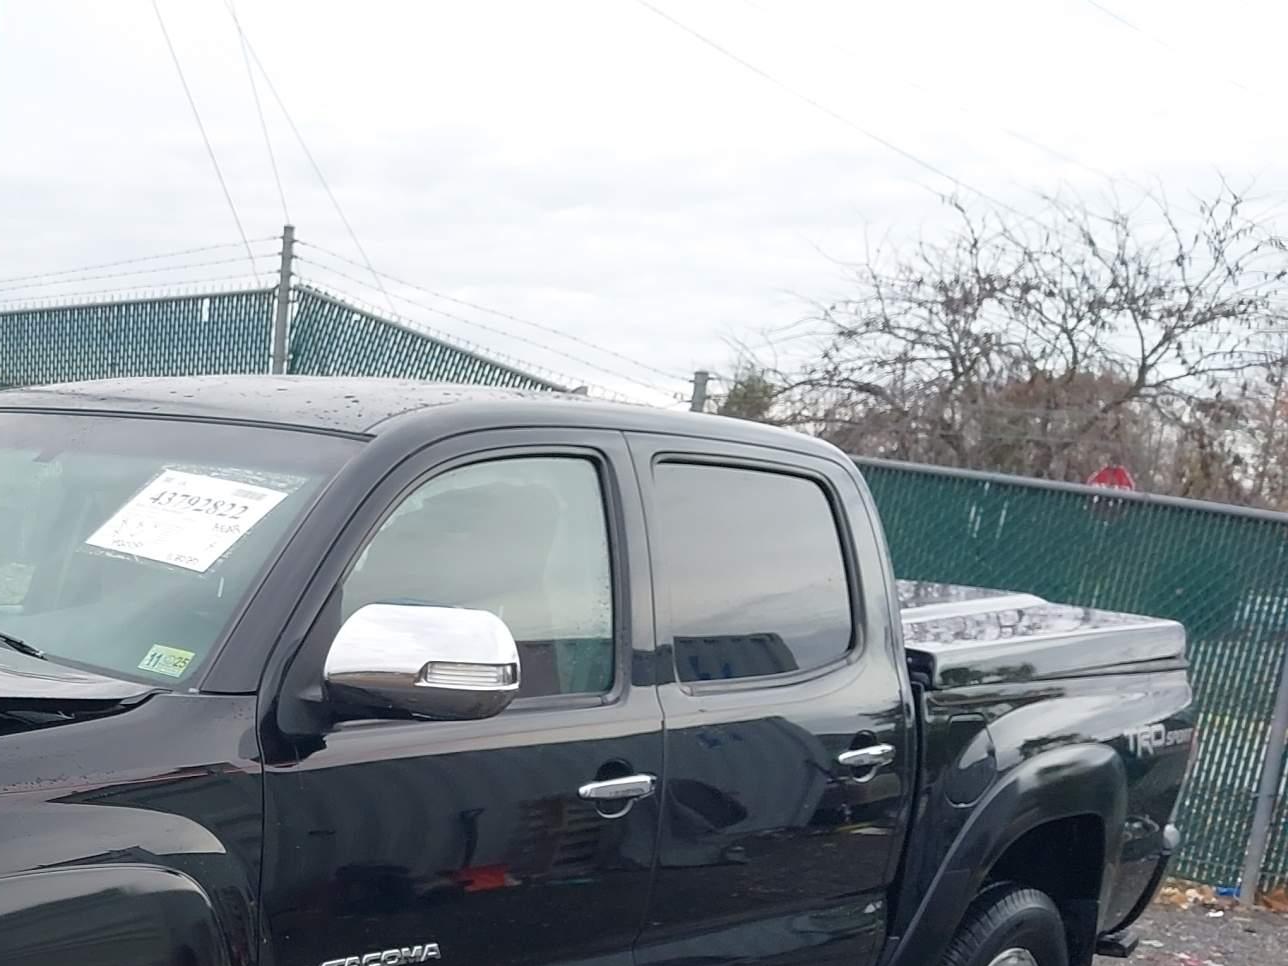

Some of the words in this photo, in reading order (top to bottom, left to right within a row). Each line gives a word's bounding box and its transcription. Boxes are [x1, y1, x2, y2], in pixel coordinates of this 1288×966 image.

[150, 490, 248, 519] 43792822
[146, 652, 162, 667] 11
[173, 656, 190, 668] 25
[1123, 723, 1165, 758] TRD
